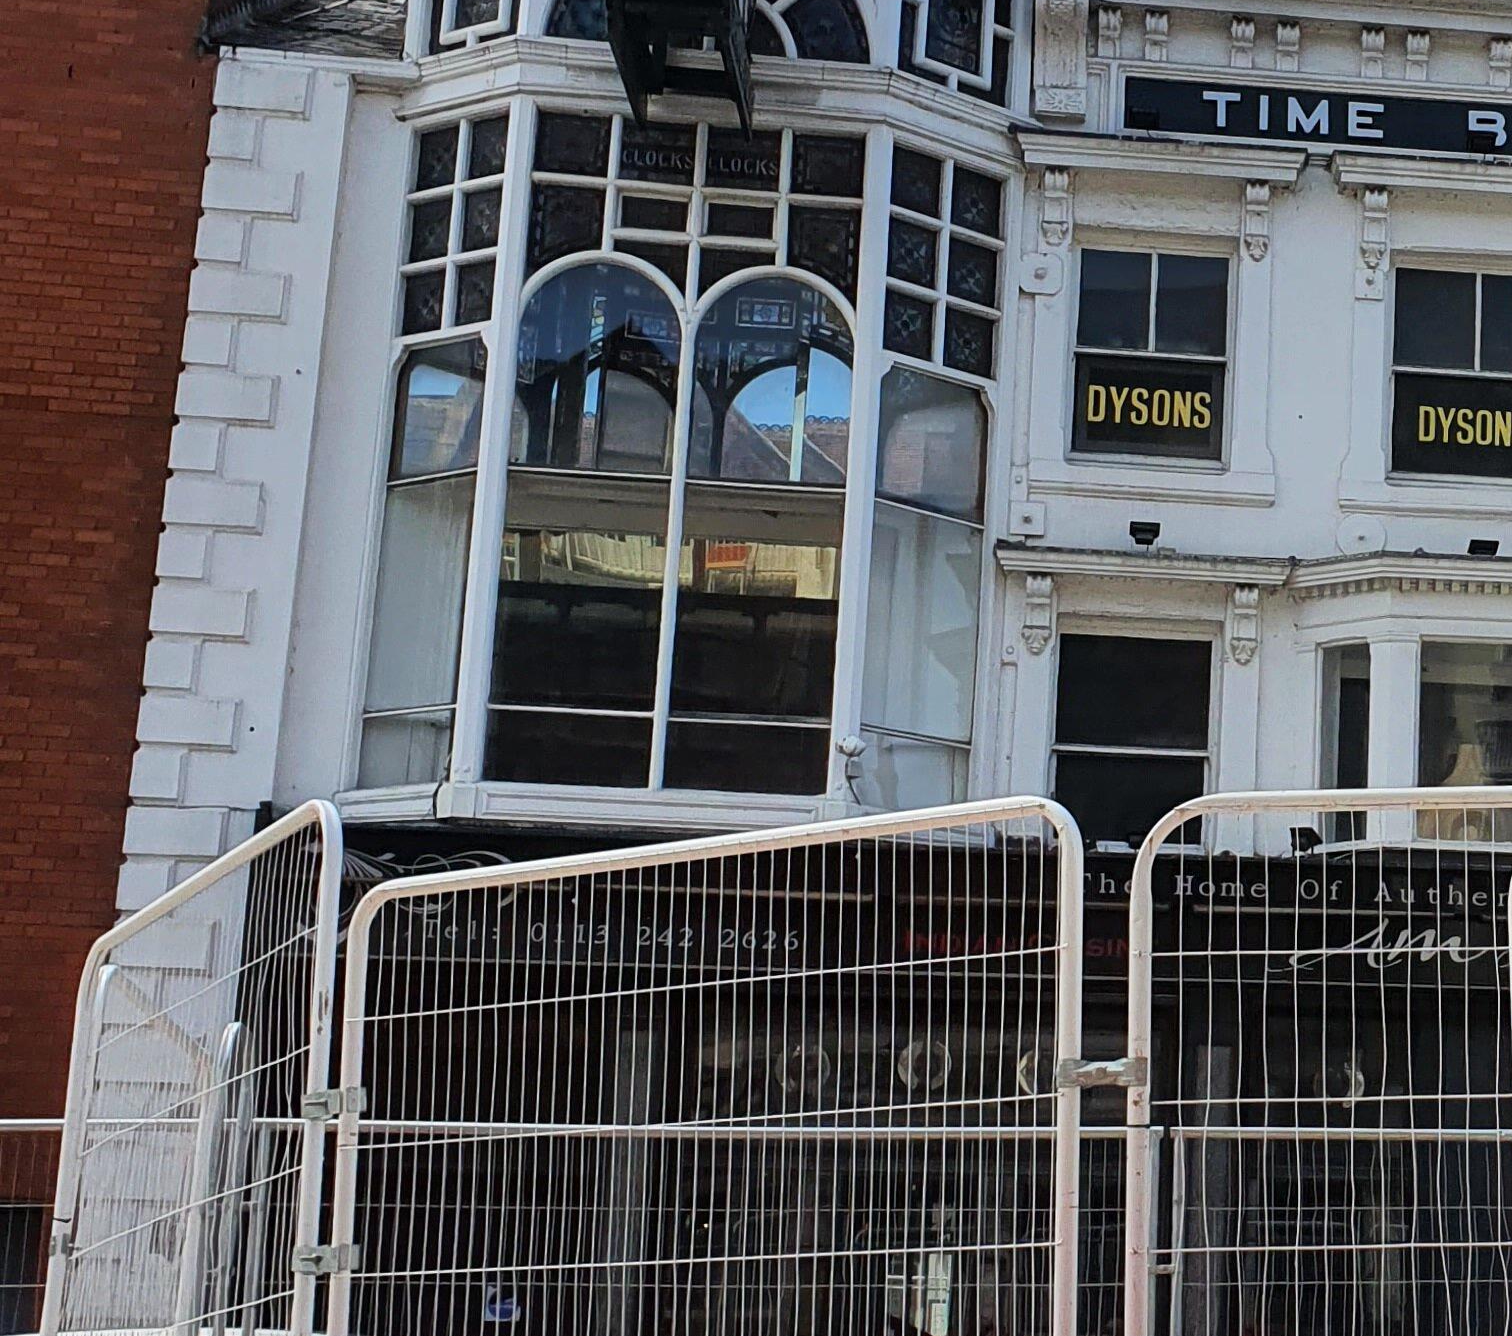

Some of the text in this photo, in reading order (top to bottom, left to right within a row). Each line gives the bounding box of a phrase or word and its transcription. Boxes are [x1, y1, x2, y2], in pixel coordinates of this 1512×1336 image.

[1203, 90, 1385, 139] TIME
[708, 155, 778, 176] LOCKS
[1087, 384, 1212, 429] DYSONS
[1173, 874, 1268, 898] Home
[1300, 878, 1342, 901] Of
[423, 918, 498, 941] Tel:
[637, 925, 693, 947] 242
[720, 927, 799, 951] 2626
